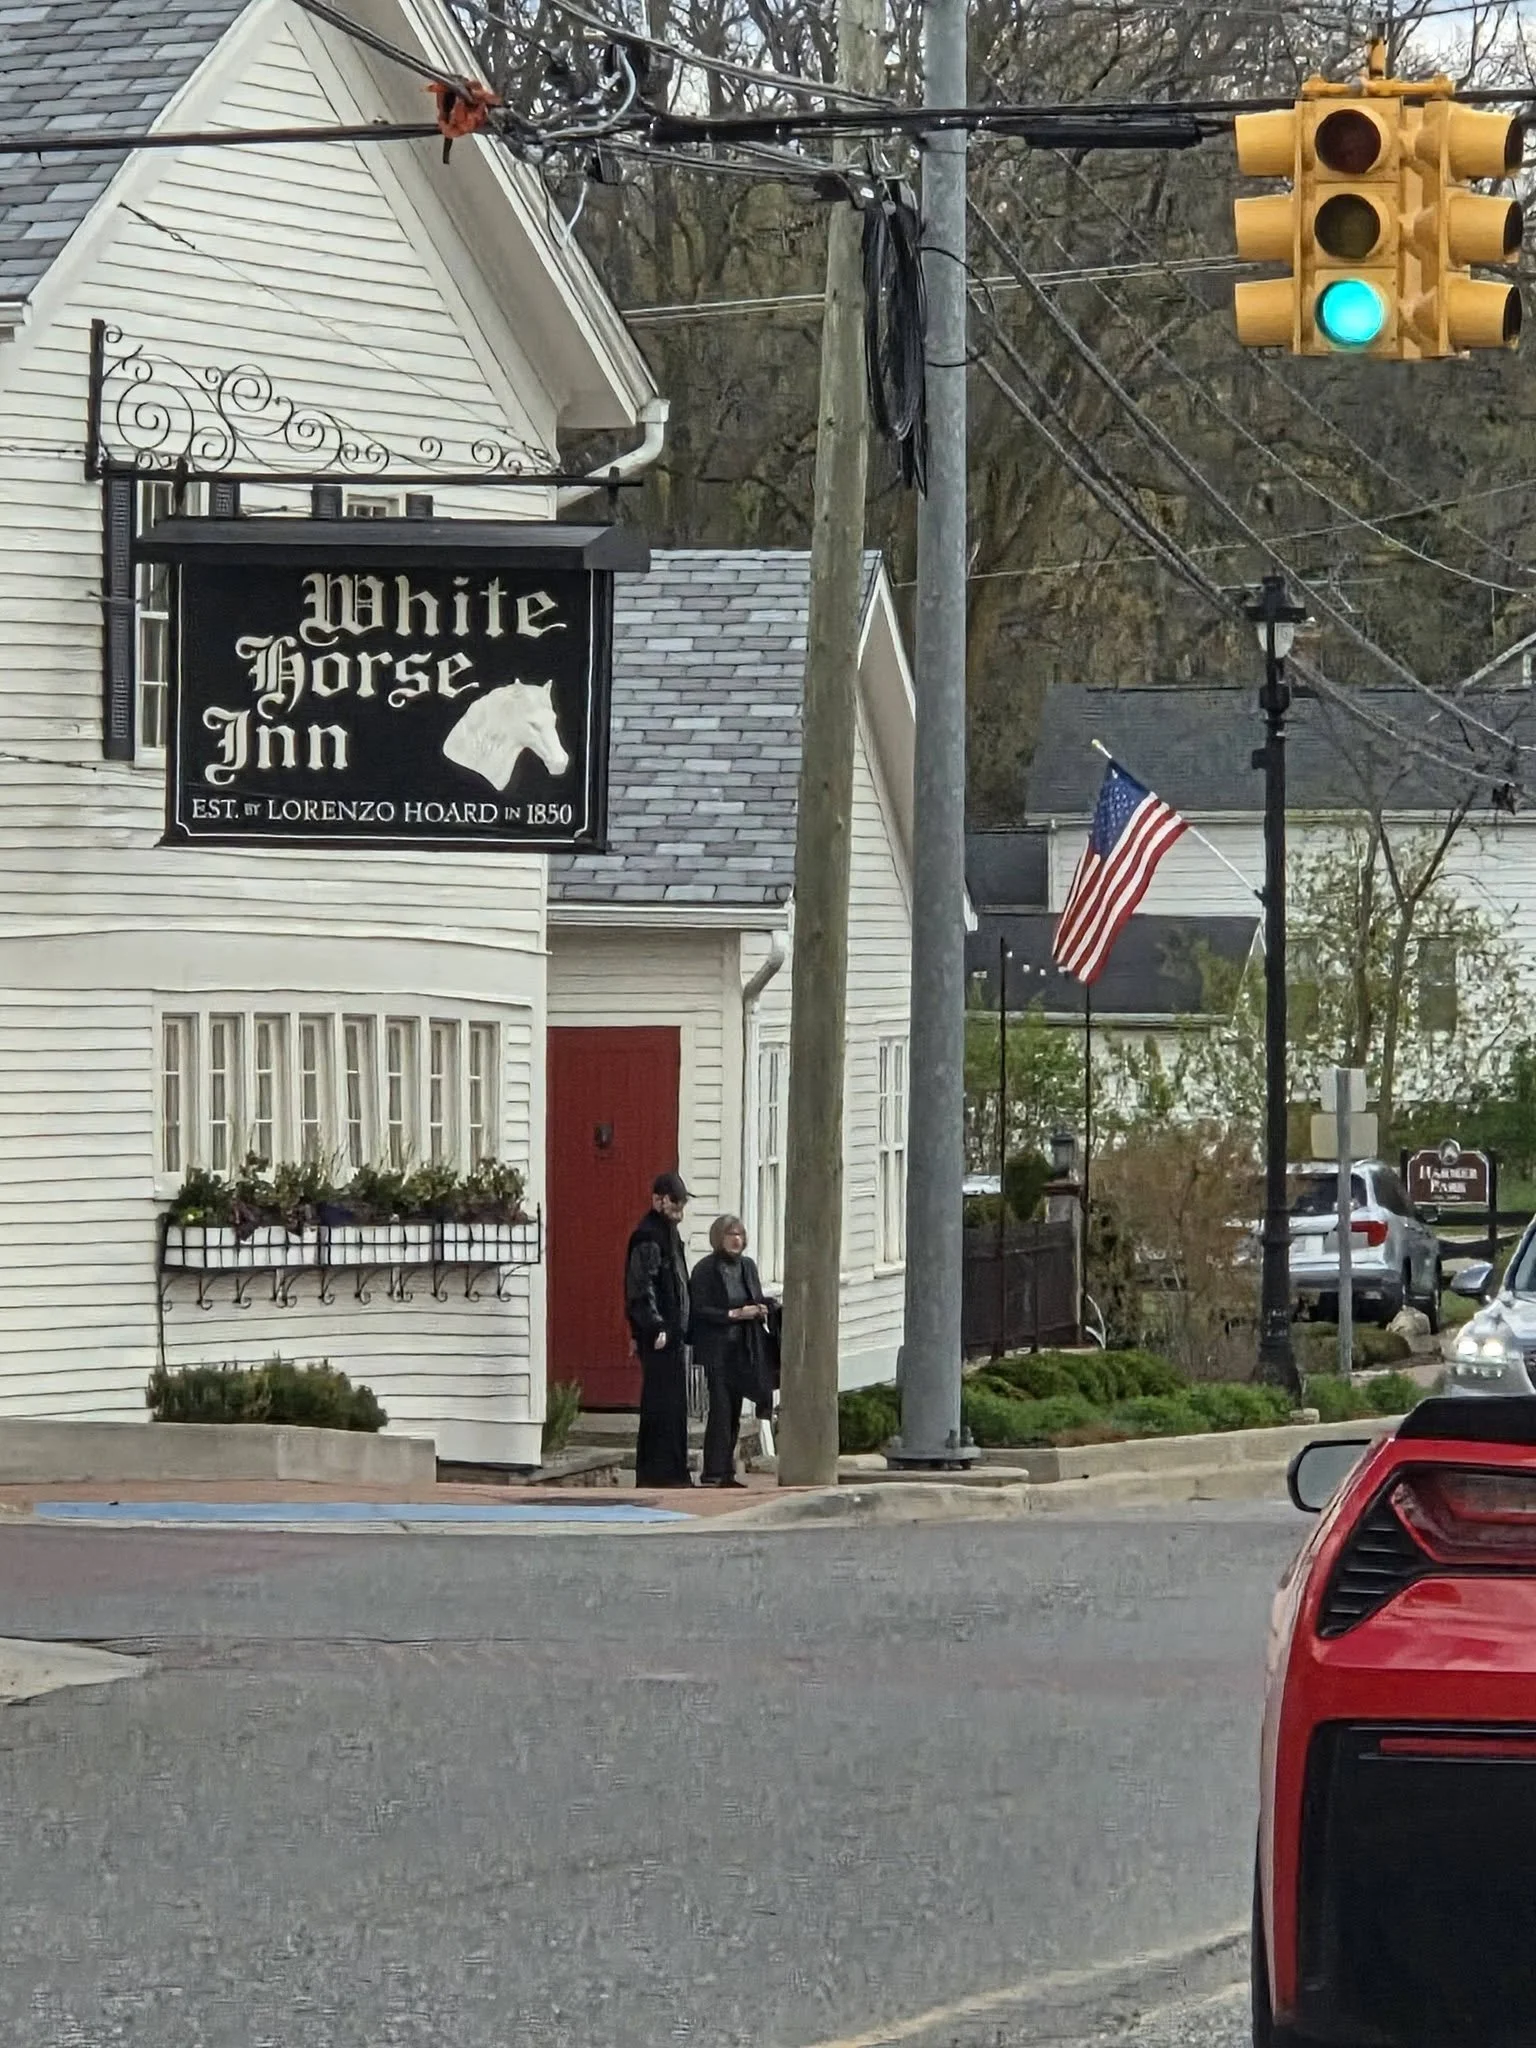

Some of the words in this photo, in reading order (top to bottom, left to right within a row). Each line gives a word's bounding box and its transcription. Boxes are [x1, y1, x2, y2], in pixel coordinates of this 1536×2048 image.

[299, 573, 567, 646] White
[235, 635, 480, 720] Horse
[202, 706, 348, 786] Inn
[192, 798, 239, 819] EST.
[244, 803, 260, 816] BY
[268, 799, 395, 821] LORENZO
[404, 801, 498, 823] HOARD
[505, 806, 520, 819] IN
[526, 803, 572, 824] 1850
